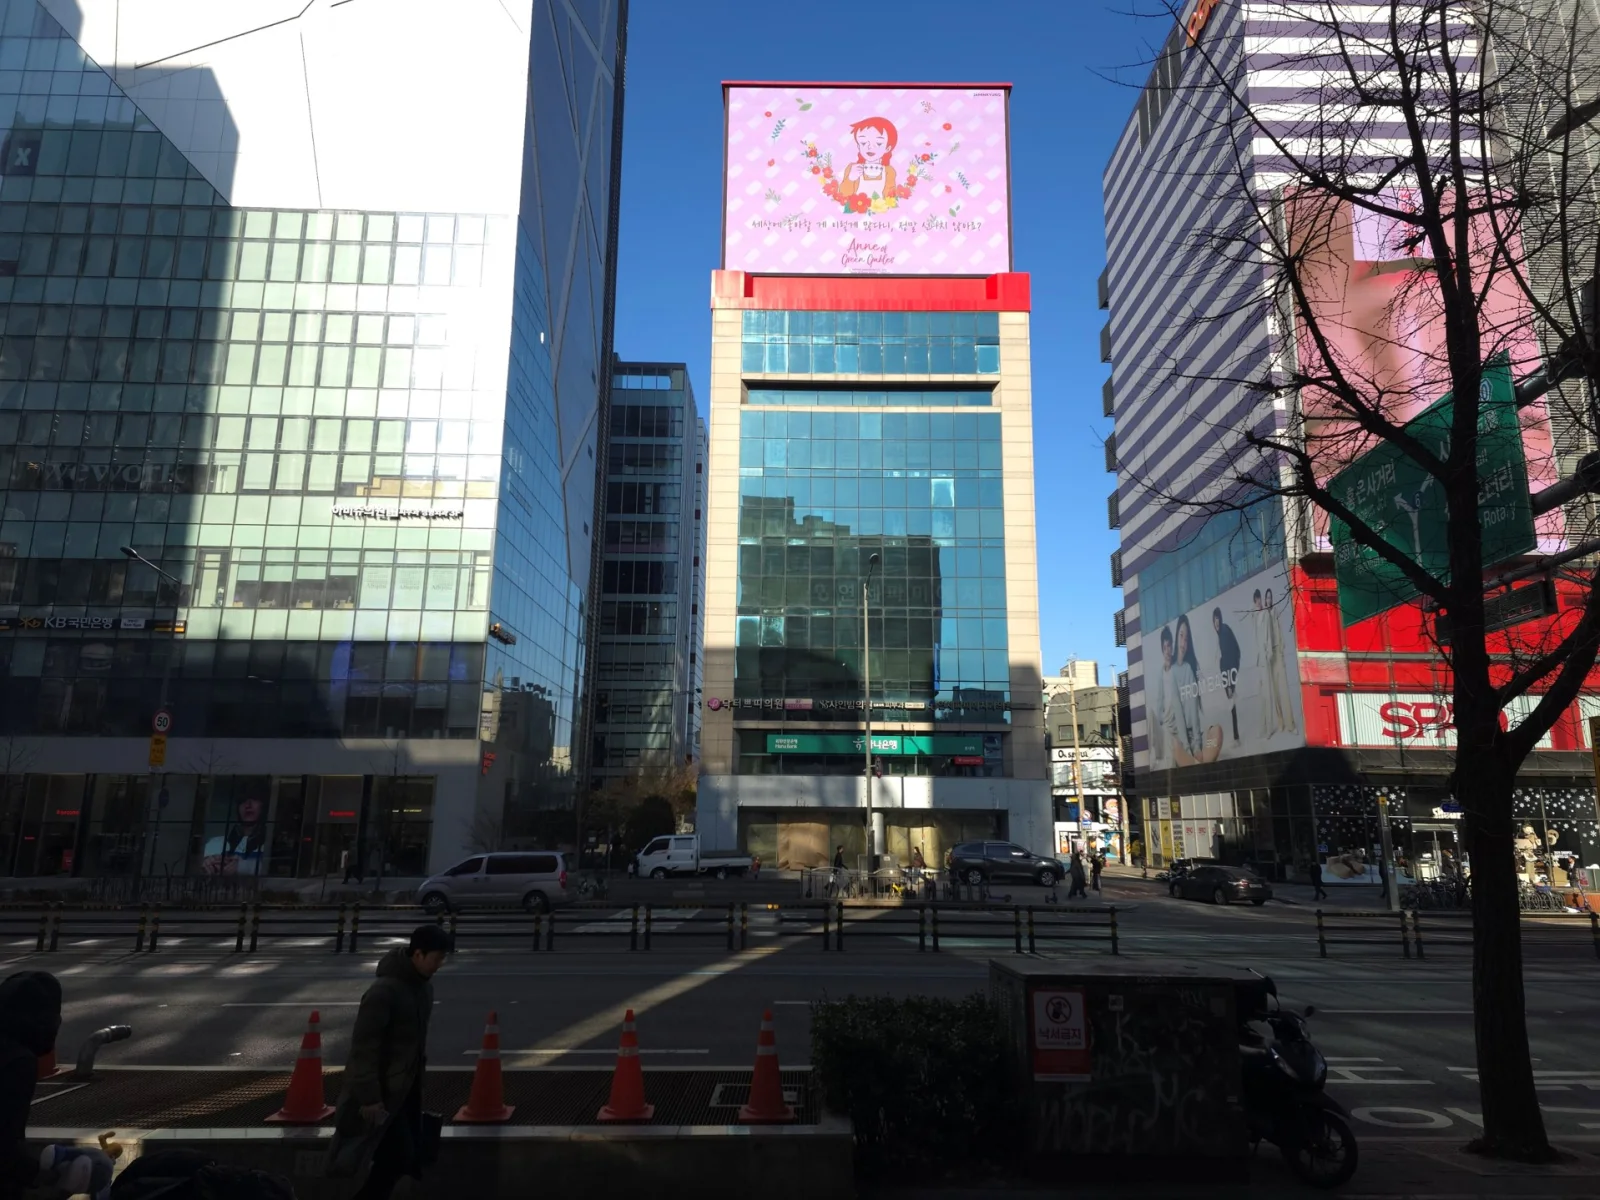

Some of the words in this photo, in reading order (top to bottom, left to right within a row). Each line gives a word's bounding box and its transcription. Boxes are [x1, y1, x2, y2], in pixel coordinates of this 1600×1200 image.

[751, 219, 783, 231] 세상에
[832, 219, 859, 232] 이렇게
[898, 220, 917, 233] 정말
[953, 220, 983, 233] 않아요?
[847, 238, 880, 257] Anne
[841, 253, 866, 267] Green
[867, 253, 896, 267] Gables
[44, 463, 186, 484] wework
[1345, 458, 1397, 511] 홍은사거리
[44, 617, 114, 629] KB국민은행
[1180, 680, 1207, 702] FROM
[1208, 667, 1238, 692] BASIC
[722, 698, 784, 712] 닥터쁘띠의원
[157, 716, 168, 727] 50
[1038, 1027, 1081, 1040] 낙서금지
